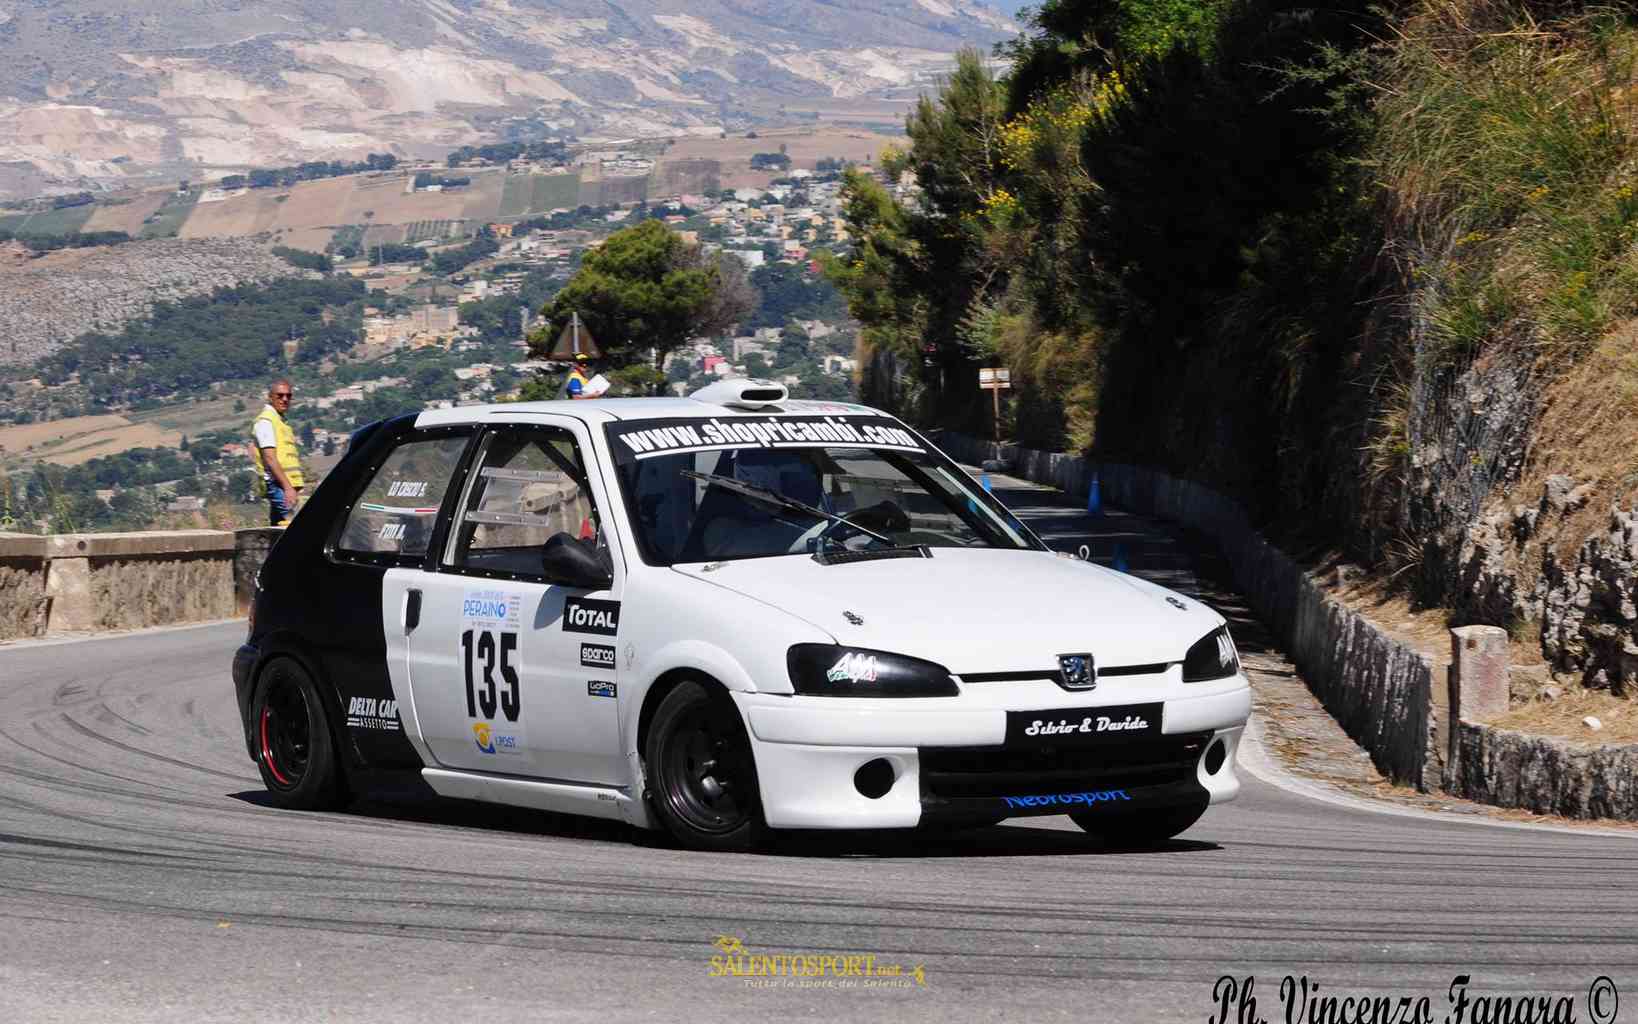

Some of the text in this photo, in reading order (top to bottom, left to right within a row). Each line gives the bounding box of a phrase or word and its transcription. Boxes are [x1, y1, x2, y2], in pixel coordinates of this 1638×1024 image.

[620, 417, 919, 448] www.shopricambi.com
[464, 599, 506, 618] PERAINO
[582, 647, 614, 662] sparco
[462, 629, 520, 722] 135
[348, 697, 400, 718] DELTA CAR
[360, 717, 387, 729] ASSETTO
[1025, 716, 1149, 736] Silvio & Davide
